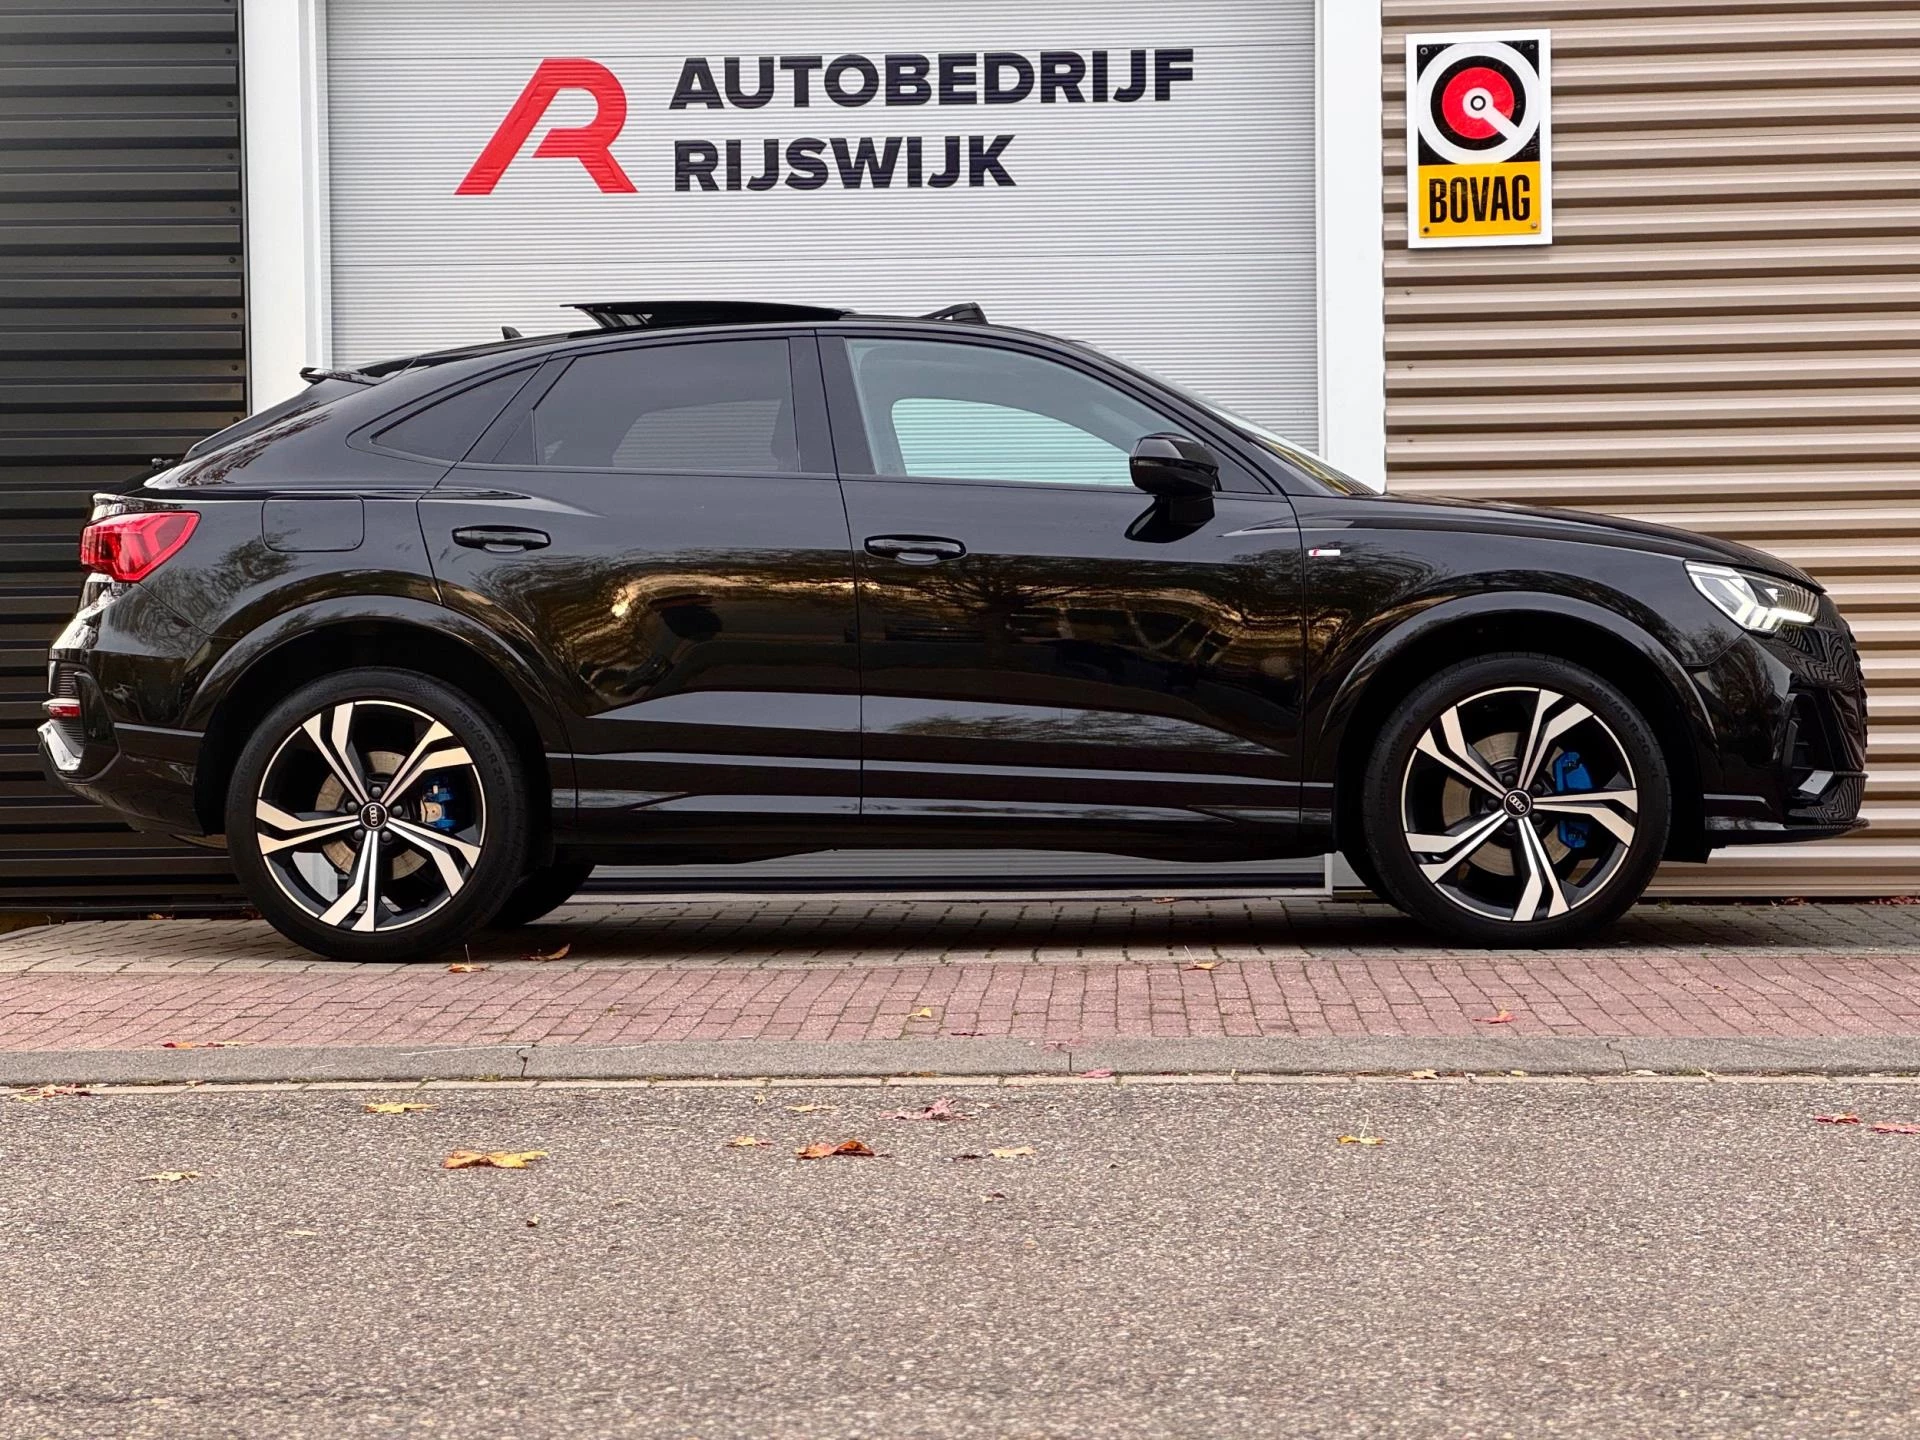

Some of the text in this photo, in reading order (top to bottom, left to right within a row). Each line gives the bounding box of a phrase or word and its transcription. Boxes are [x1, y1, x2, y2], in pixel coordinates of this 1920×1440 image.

[669, 49, 1193, 109] AUTOBEDRIJF
[675, 135, 1016, 191] RIJSWIJK
[1430, 175, 1529, 223] BOVAG
